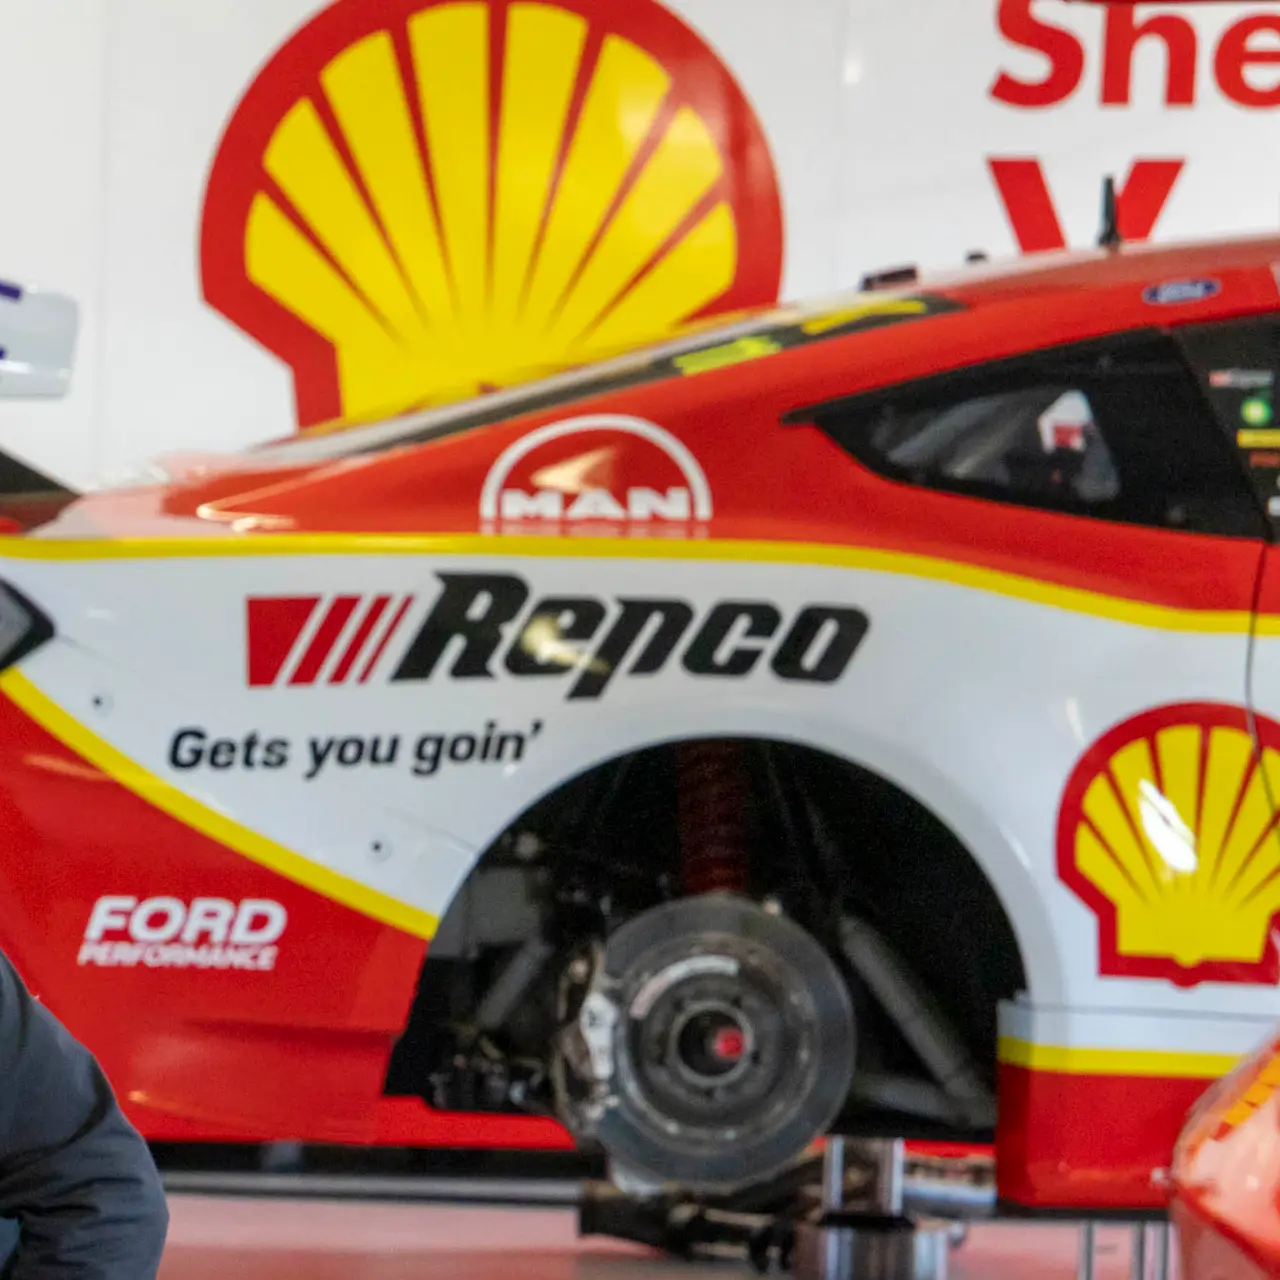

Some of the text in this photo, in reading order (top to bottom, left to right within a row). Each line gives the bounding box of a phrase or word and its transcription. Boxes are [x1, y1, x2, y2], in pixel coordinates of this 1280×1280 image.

[501, 487, 691, 520] MAN
[390, 571, 869, 702] Repco
[168, 727, 288, 771] Gets
[308, 734, 398, 780] you
[83, 895, 288, 945] FORD
[77, 942, 279, 971] PERFORMANCE
